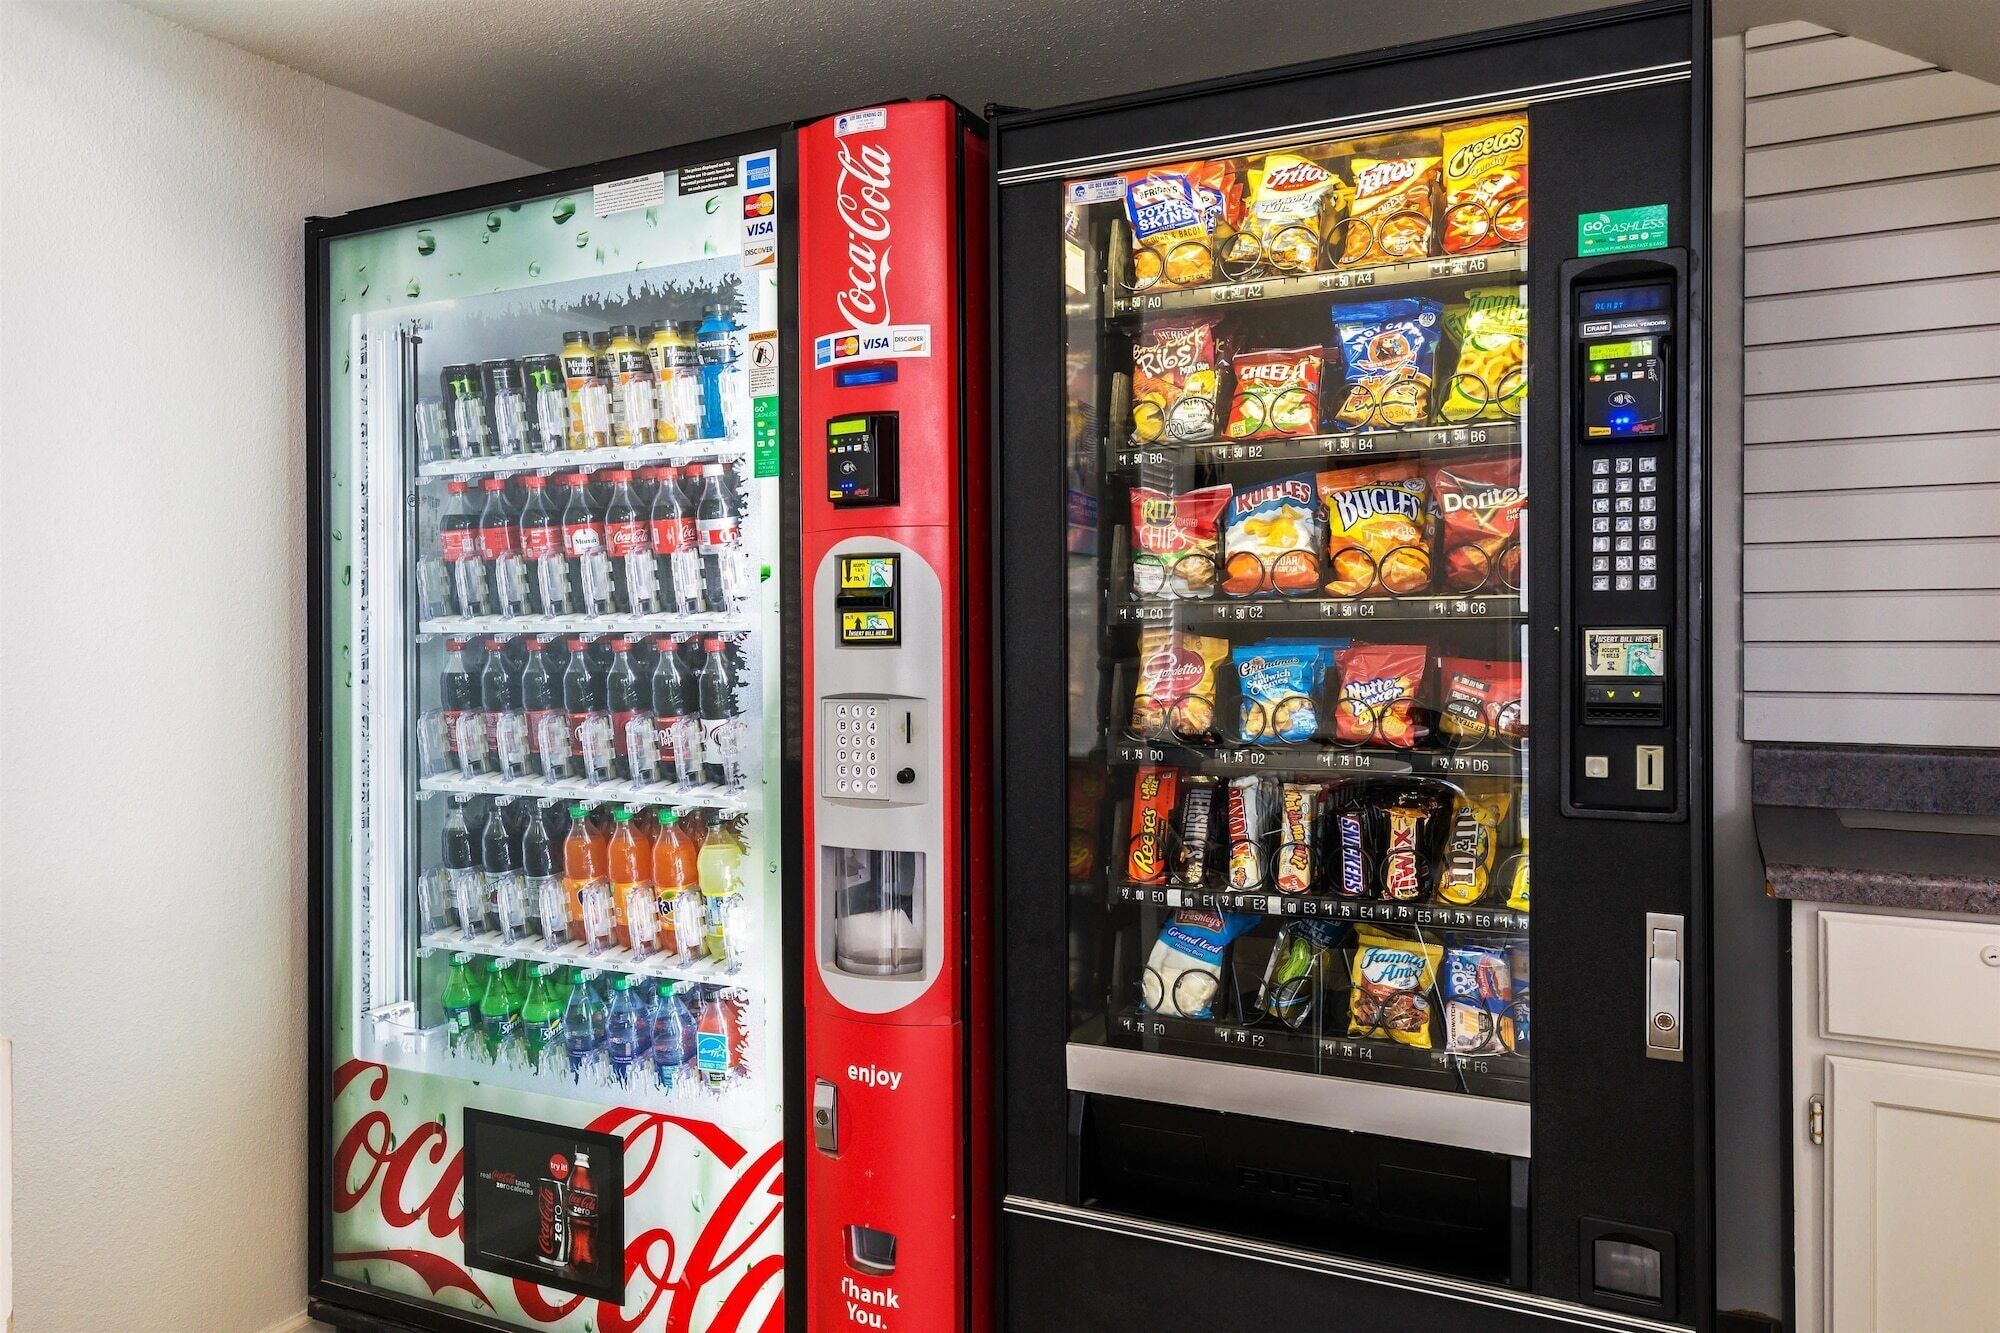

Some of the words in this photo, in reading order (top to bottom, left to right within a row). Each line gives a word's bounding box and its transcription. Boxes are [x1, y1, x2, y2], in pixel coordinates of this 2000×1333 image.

[1448, 126, 1524, 178] Cheetos
[1470, 154, 1508, 179] Crunchy
[1266, 162, 1330, 189] Fritos
[1355, 160, 1416, 200] Fritos
[1139, 208, 1193, 231] SKINS
[747, 221, 774, 236] VISA
[1583, 221, 1604, 232] GO
[1601, 217, 1665, 235] CASHLESS
[836, 137, 892, 328] Coca-Cola
[744, 246, 773, 258] DISCOVER
[1609, 243, 1637, 251] PURCHASES
[1469, 258, 1485, 271] A6
[1357, 274, 1372, 284] A4
[1247, 285, 1262, 297] A2
[1147, 297, 1161, 308] A0
[1421, 313, 1434, 322] 210
[1586, 324, 1609, 333] CRANE
[863, 337, 890, 350] VISA
[894, 335, 924, 343] DISCOVER
[1136, 344, 1192, 379] Ribs
[571, 366, 592, 376] Maid
[1470, 431, 1486, 442] B6
[1358, 439, 1374, 450] B4
[1149, 452, 1163, 464] B0
[1248, 446, 1263, 458] B2
[1235, 481, 1312, 515] RUFFLES
[1143, 498, 1176, 526] RITZ
[1330, 487, 1421, 533] BUGLES
[1176, 516, 1199, 528] TOASTED
[613, 528, 649, 545] Coca-Cola
[1139, 525, 1189, 550] CHIPS
[1150, 608, 1163, 620] C0
[1249, 607, 1263, 618] C2
[1359, 605, 1375, 616] C4
[1470, 603, 1486, 614] C6
[1595, 634, 1619, 643] INSERT
[1619, 635, 1634, 643] BILL
[1634, 635, 1652, 643] HERE
[1144, 652, 1207, 693] Gardetto's
[1247, 668, 1292, 689] Sandwich
[1346, 677, 1400, 701] Nutter
[839, 707, 847, 716] A
[855, 707, 860, 716] 1
[870, 707, 876, 716] 2
[840, 721, 847, 730] B
[855, 721, 861, 731] 3
[870, 722, 876, 731] 4
[840, 736, 847, 745] C
[855, 736, 861, 746] 5
[870, 737, 876, 746] 6
[840, 751, 847, 760] D
[855, 751, 861, 760] 7
[870, 752, 876, 761] 8
[1150, 750, 1164, 761] D0
[1251, 753, 1265, 764] D2
[1355, 756, 1370, 767] D4
[840, 766, 846, 775] E
[855, 766, 861, 776] 9
[870, 767, 876, 776] 0
[1473, 759, 1489, 772] D6
[840, 781, 846, 789] F
[1142, 773, 1157, 801] LARGE
[1149, 779, 1160, 797] SIZE
[1228, 787, 1251, 859] PAYDAY
[1133, 807, 1158, 875] Reese's
[1340, 816, 1363, 893] SNICKERS
[1387, 827, 1418, 891] TWIX
[1151, 891, 1165, 902] E0
[1202, 894, 1215, 906] E1
[1253, 898, 1266, 910] E2
[1303, 902, 1317, 914] E3
[1360, 906, 1374, 918] E4
[1417, 910, 1432, 922] E5
[1179, 909, 1223, 928] Freshley's
[1475, 915, 1491, 927] E6
[1167, 926, 1200, 947] Grand
[1197, 939, 1225, 955] Iced
[1174, 942, 1192, 953] Honey
[1191, 948, 1204, 958] Bun
[1360, 947, 1428, 970] Famous
[1153, 1024, 1165, 1035] F0
[1252, 1035, 1265, 1047] F2
[1359, 1048, 1373, 1060] F4
[1474, 1061, 1488, 1074] F6
[847, 1064, 903, 1091] enjoy
[550, 1161, 560, 1171] try
[480, 1171, 492, 1180] real
[515, 1179, 531, 1188] taste
[573, 1205, 591, 1216] zero
[539, 1185, 555, 1256] Coca-Cola
[554, 1204, 562, 1242] zero
[846, 1300, 888, 1330] You.
